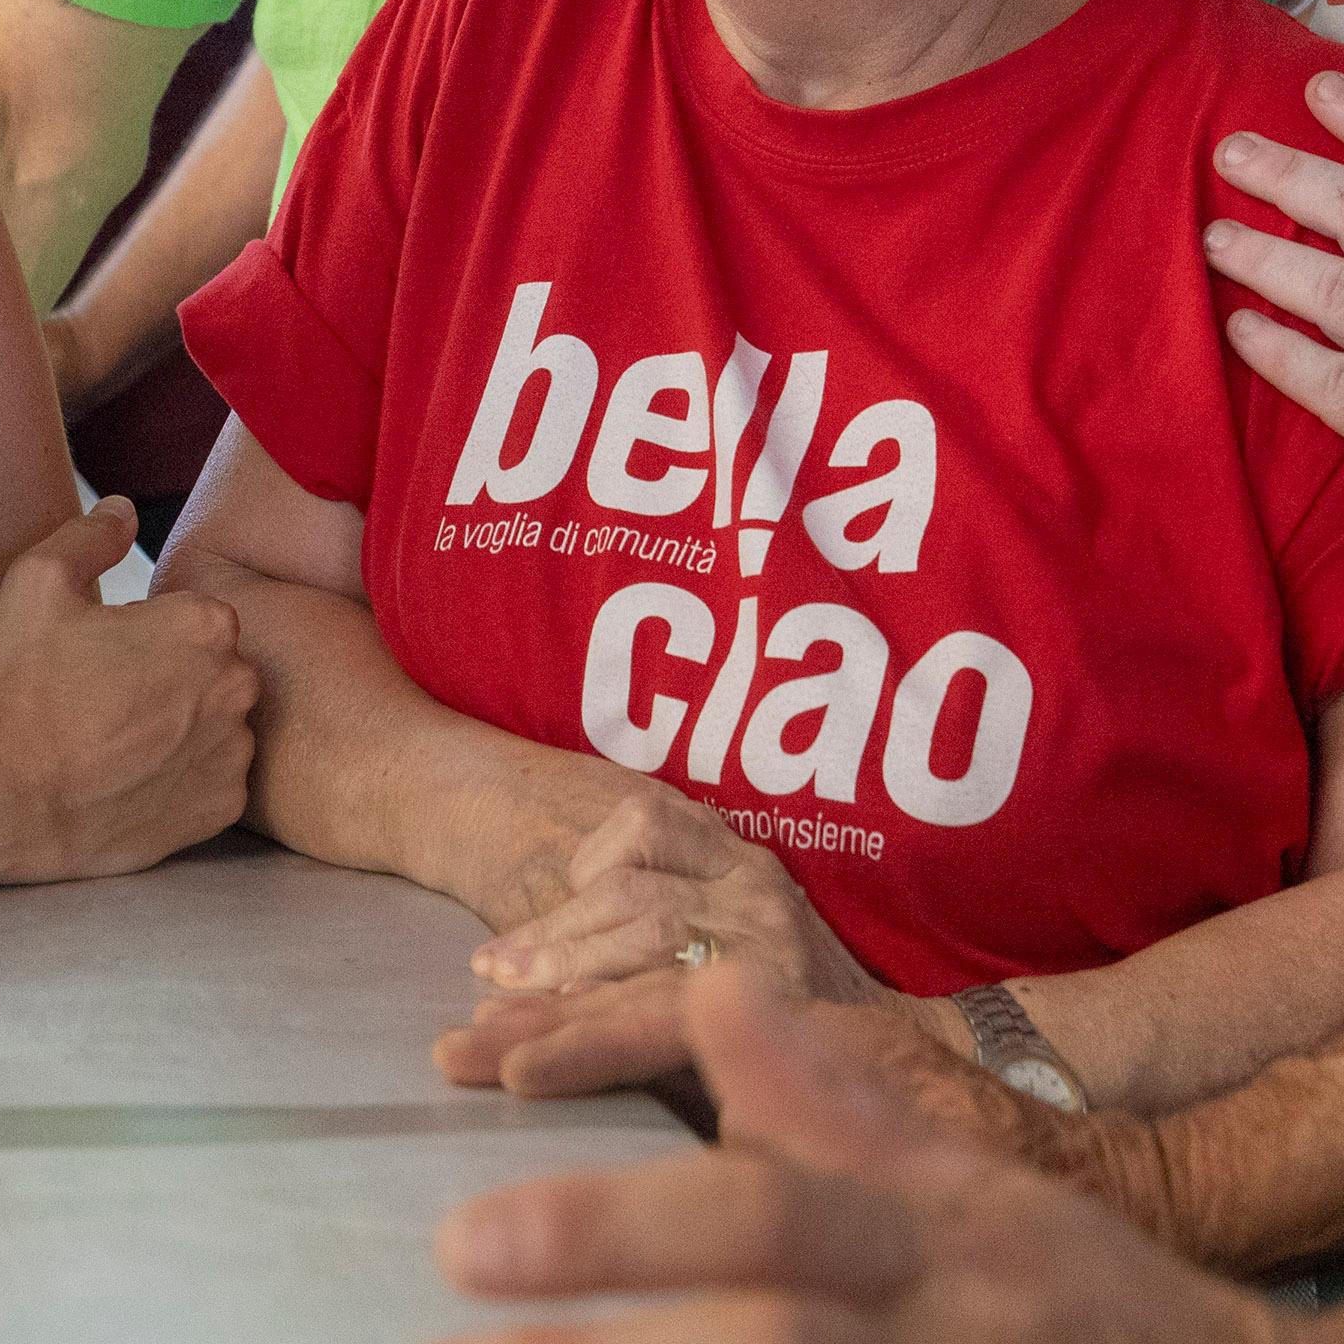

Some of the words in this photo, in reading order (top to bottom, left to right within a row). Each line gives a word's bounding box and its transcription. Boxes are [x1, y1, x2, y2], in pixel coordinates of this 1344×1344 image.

[433, 516, 457, 552] la
[462, 511, 543, 555] voglia
[549, 519, 581, 556] di
[583, 524, 718, 575] comunità
[445, 281, 938, 574] bella
[581, 528, 1034, 828] ciao
